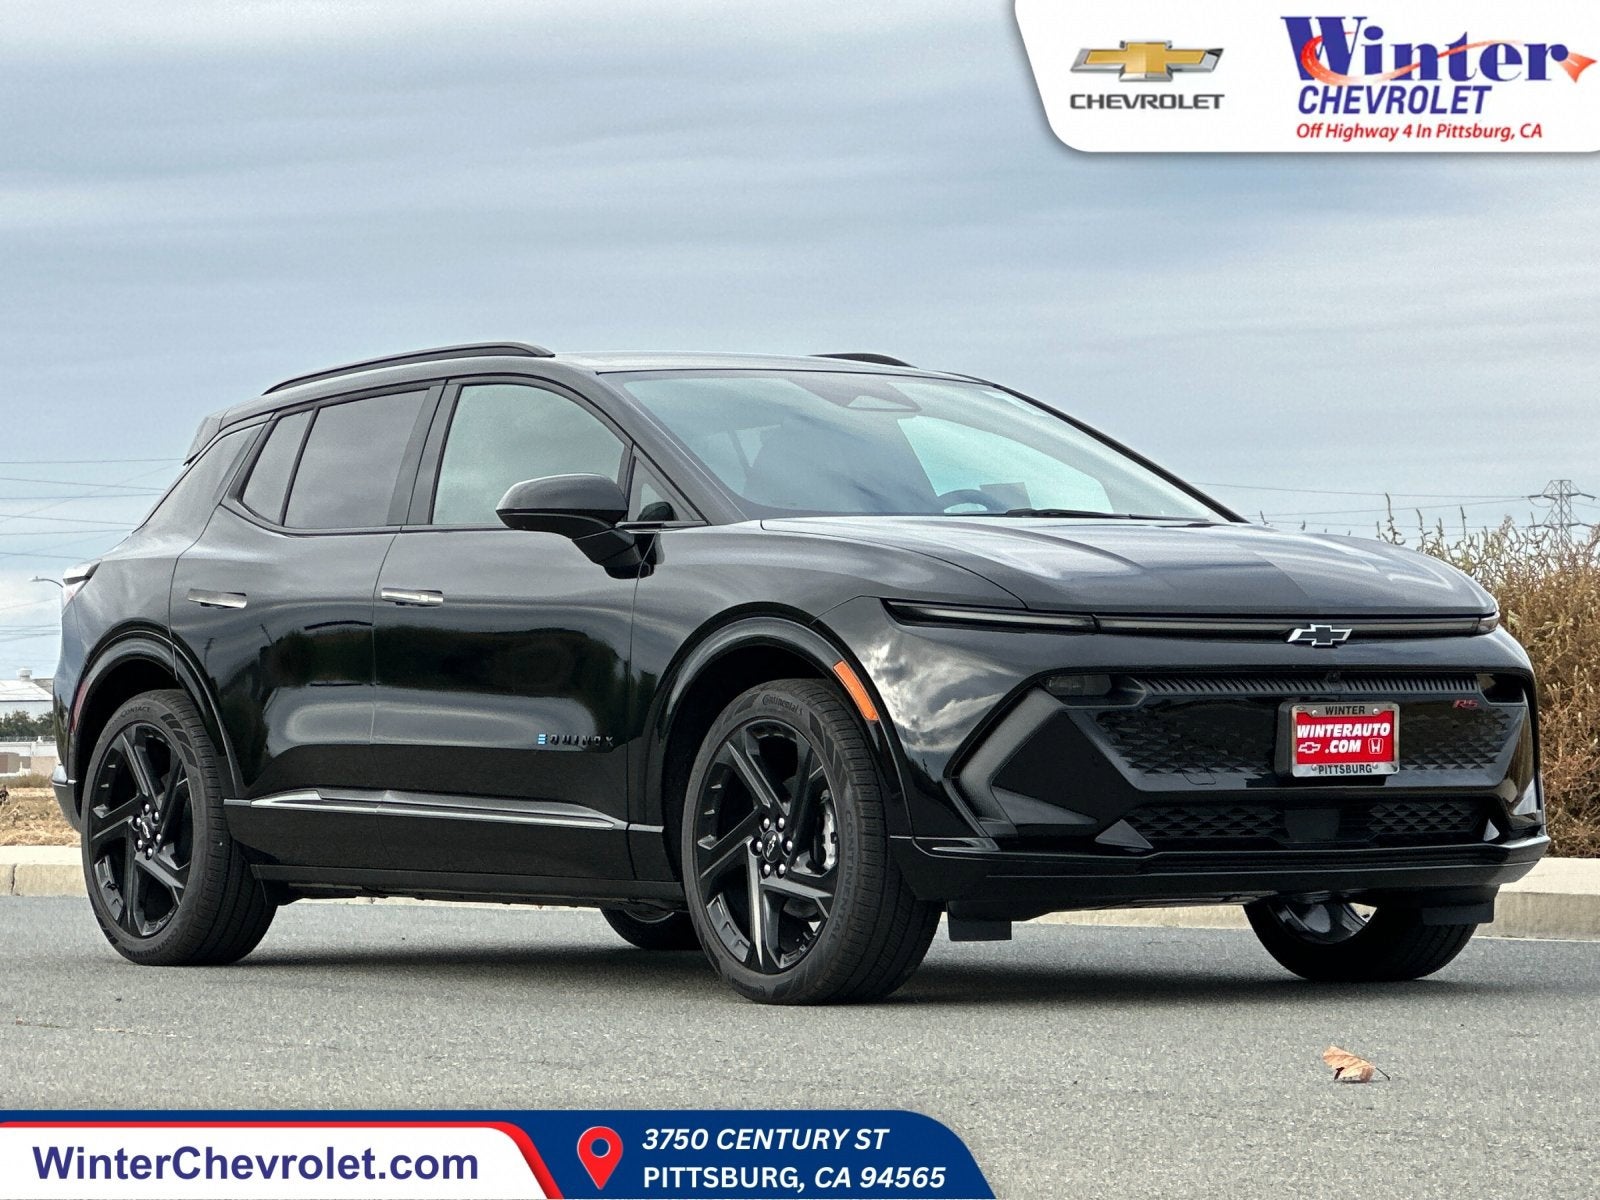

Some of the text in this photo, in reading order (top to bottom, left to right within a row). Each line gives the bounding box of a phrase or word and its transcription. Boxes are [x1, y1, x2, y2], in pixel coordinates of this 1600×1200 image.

[1454, 699, 1479, 709] RS
[1325, 705, 1366, 716] WINTER
[1297, 722, 1391, 739] WINTERAUTO
[537, 733, 614, 747] EQUINOX
[1324, 739, 1362, 755] .COM
[1318, 764, 1373, 775] PITTSBURG
